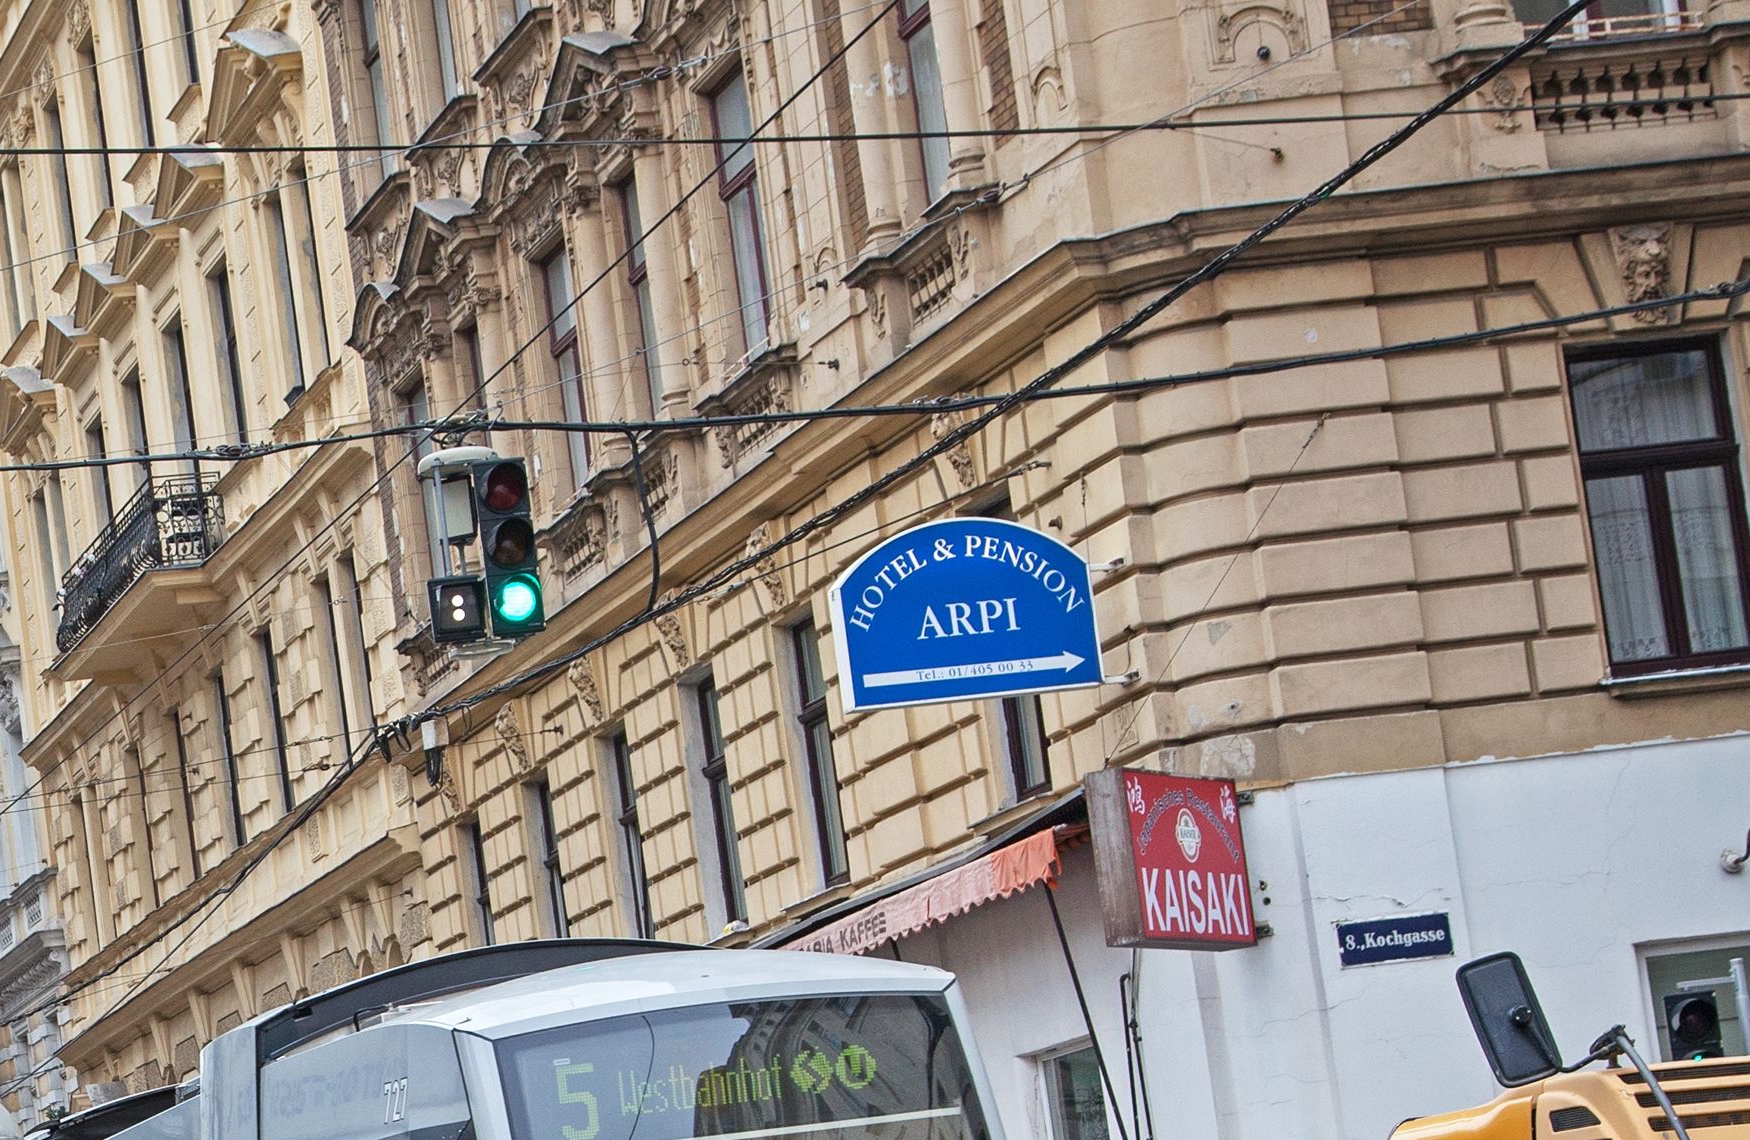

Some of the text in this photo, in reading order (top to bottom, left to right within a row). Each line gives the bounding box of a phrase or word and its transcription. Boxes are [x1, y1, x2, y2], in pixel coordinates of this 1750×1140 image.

[850, 535, 1085, 632] HOTEL & PENSION
[917, 597, 1021, 640] ARPI
[948, 664, 993, 678] 01/405
[998, 662, 1014, 673] 00
[1019, 659, 1034, 672] 33
[1141, 867, 1250, 936] KAISAKI
[840, 911, 887, 951] KAFFEE
[383, 1076, 409, 1125] 727
[555, 1061, 601, 1140] 5
[617, 1053, 782, 1116] Westbahnhof
